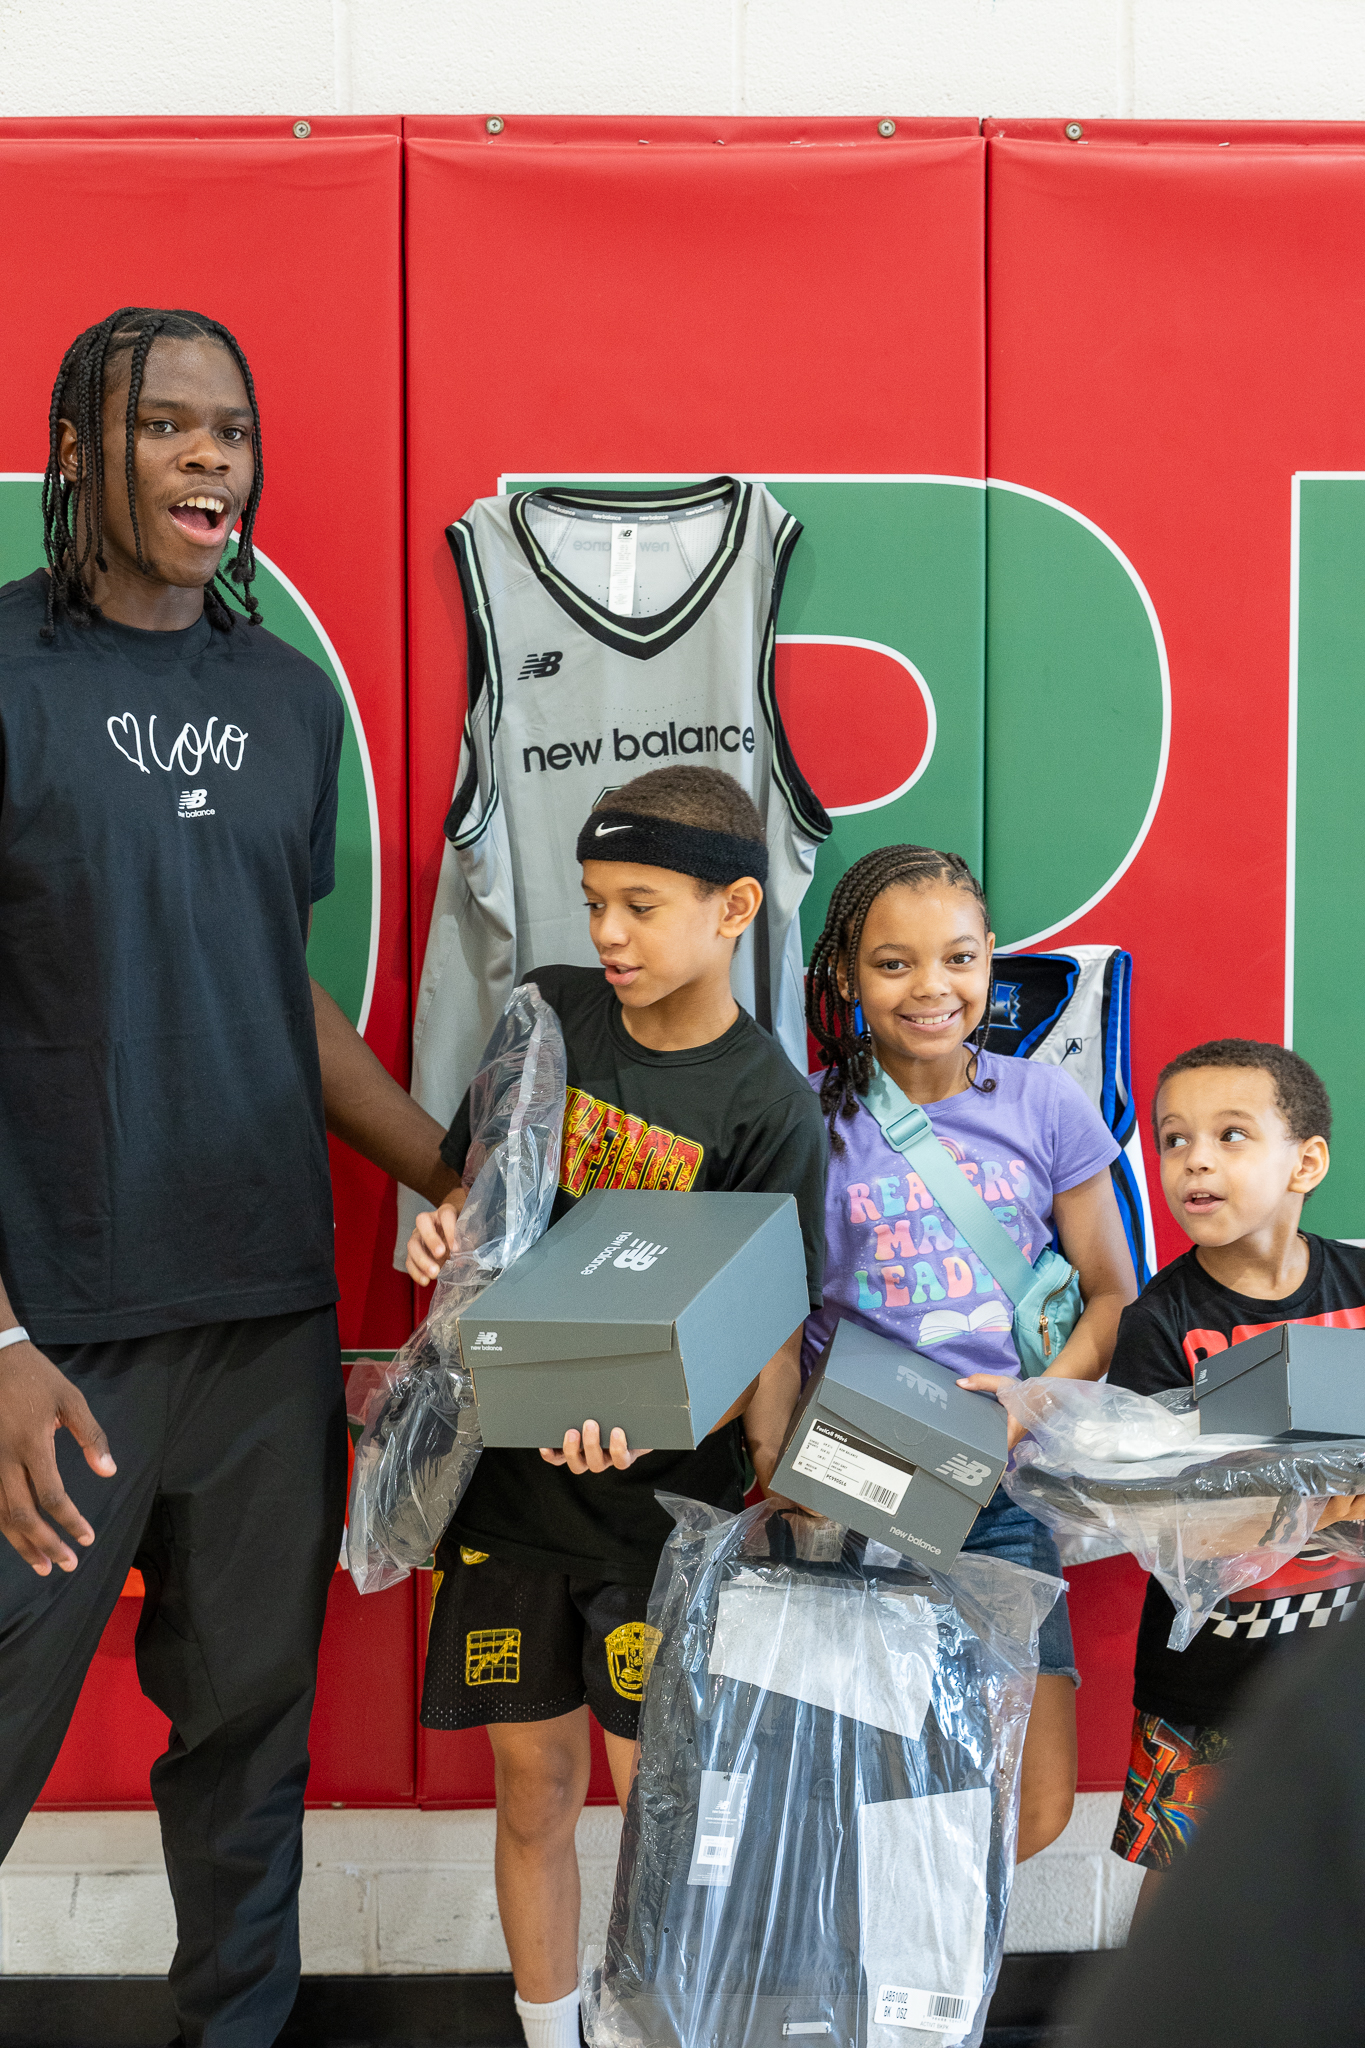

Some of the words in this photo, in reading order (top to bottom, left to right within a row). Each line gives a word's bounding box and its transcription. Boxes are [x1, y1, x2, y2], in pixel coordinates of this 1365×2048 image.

[522, 737, 602, 773] new
[612, 721, 755, 763] balance
[185, 809, 216, 819] balance
[847, 1159, 1031, 1224] REAERS
[873, 1205, 1020, 1261] MAE
[580, 1246, 622, 1276] balance
[889, 1525, 907, 1542] new
[906, 1531, 942, 1556] balance
